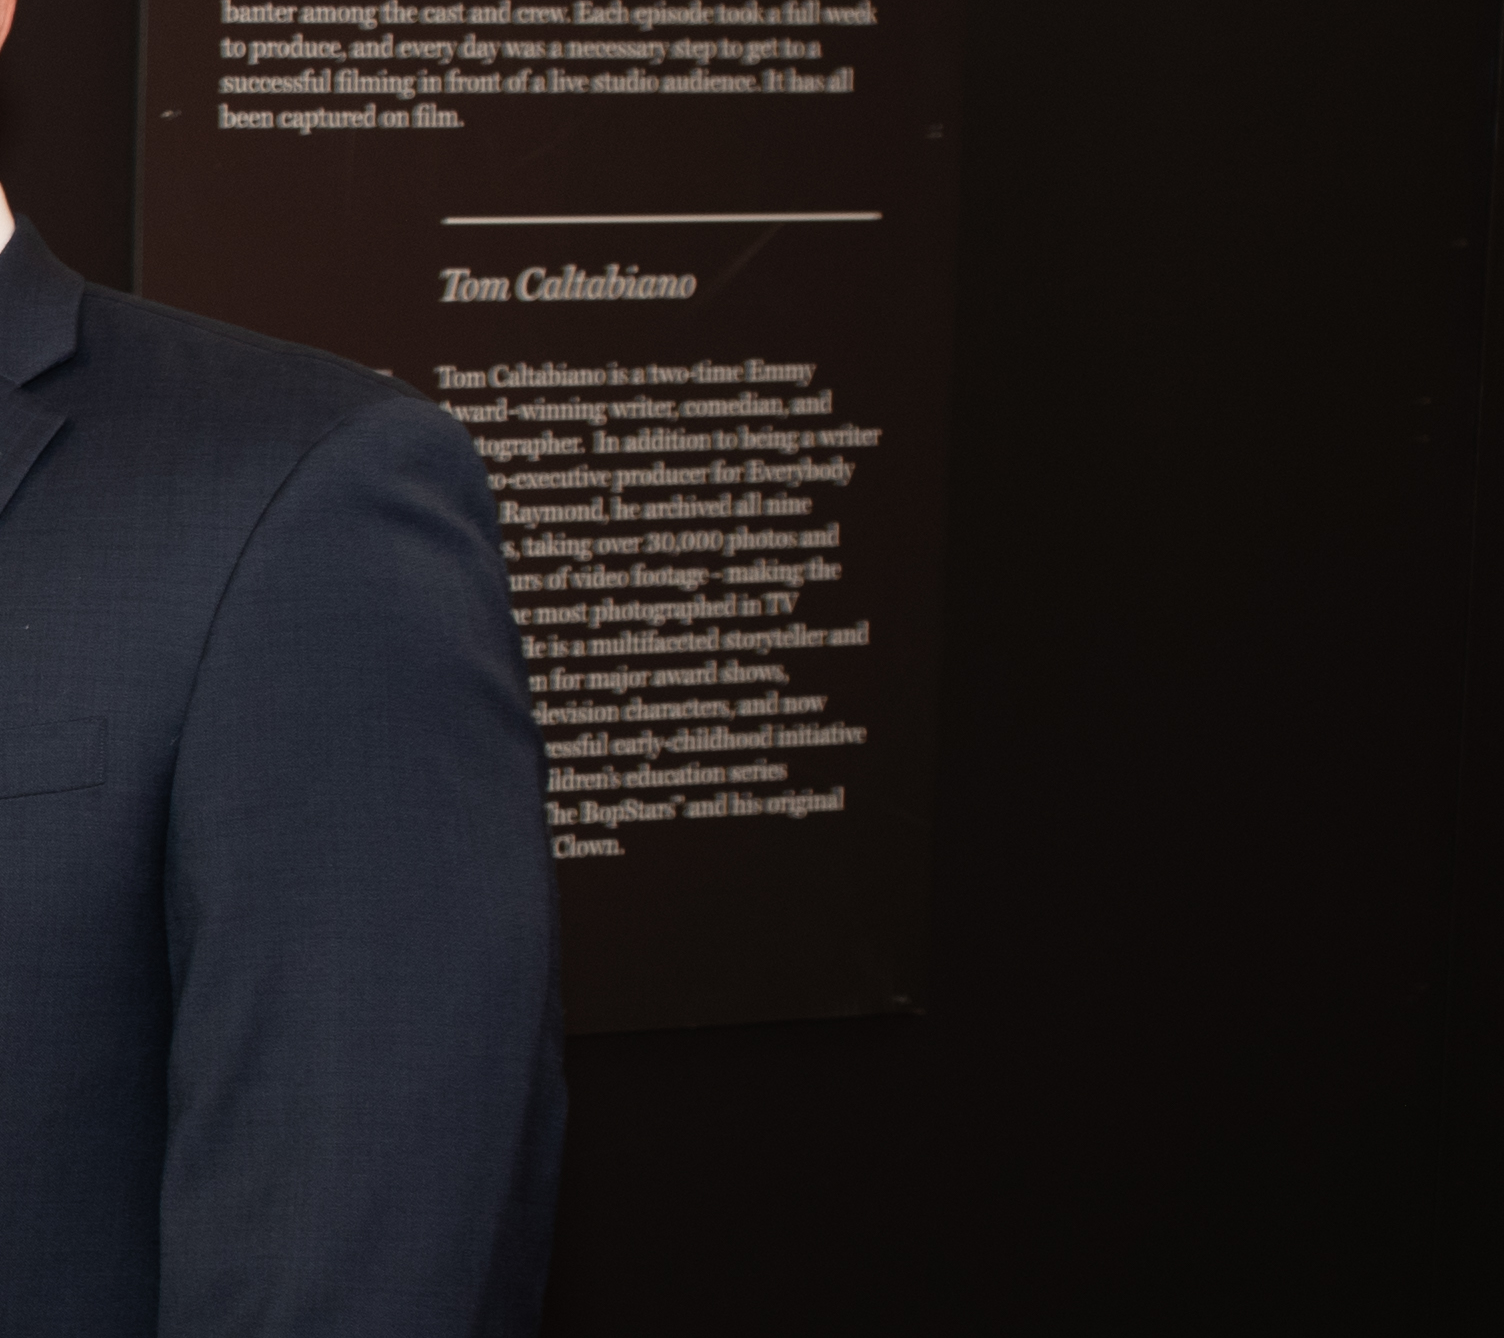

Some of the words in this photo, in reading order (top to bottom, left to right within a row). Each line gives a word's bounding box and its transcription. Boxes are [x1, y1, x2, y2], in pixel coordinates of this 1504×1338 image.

[219, 103, 274, 128] been
[277, 103, 376, 135] captured
[378, 111, 409, 128] on
[413, 103, 464, 128] film.
[441, 267, 510, 302] Tom
[516, 264, 696, 301] Caltabiano
[435, 365, 487, 389] Tom
[487, 362, 606, 389] Caltabiano
[606, 362, 629, 385] is
[629, 368, 645, 385] a
[645, 361, 743, 384] two-time
[743, 358, 815, 386] Emmy
[789, 390, 832, 415] and
[522, 532, 594, 562] taking
[594, 537, 643, 555] over
[643, 530, 724, 554] 30,000
[724, 526, 798, 556] photos
[798, 523, 839, 547] and
[624, 762, 726, 788] education
[726, 759, 787, 783] series
[552, 834, 624, 859] Clown.
